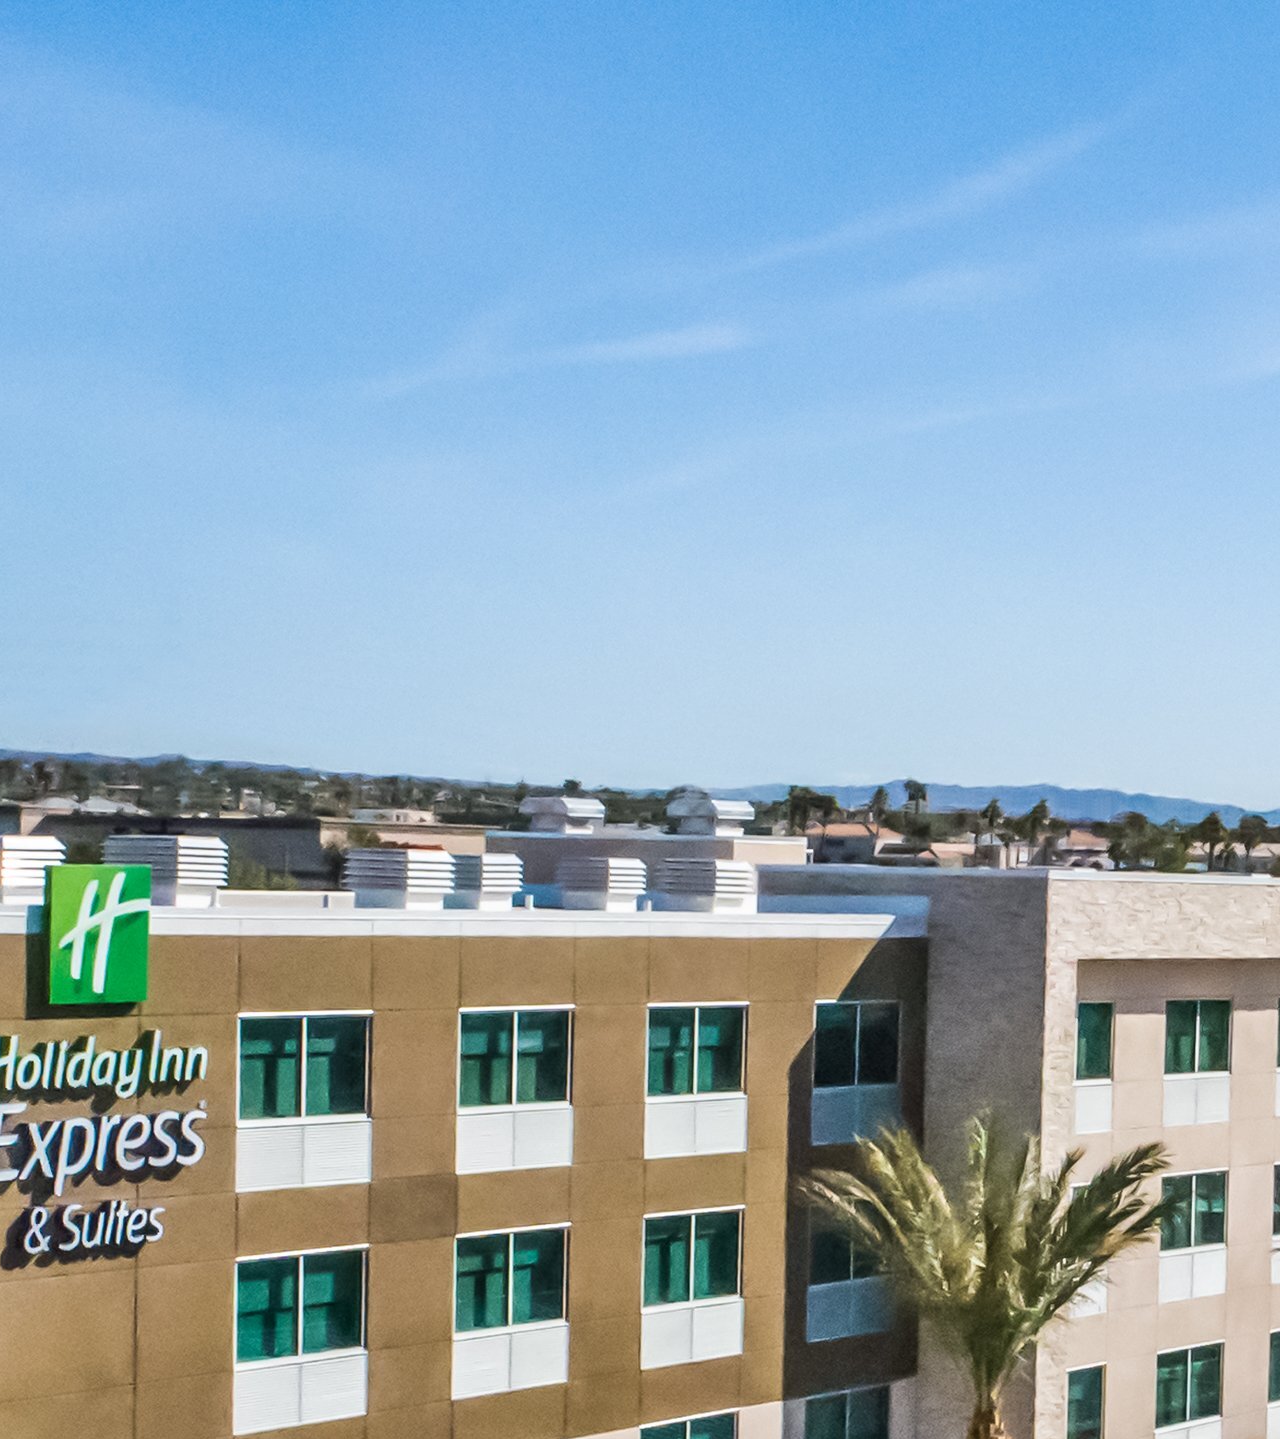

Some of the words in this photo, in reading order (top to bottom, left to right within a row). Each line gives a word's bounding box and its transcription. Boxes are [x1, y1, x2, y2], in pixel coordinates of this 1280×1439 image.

[58, 871, 150, 994] H
[149, 1030, 208, 1083] Inn
[24, 1205, 51, 1254] &
[59, 1201, 166, 1252] Suites
